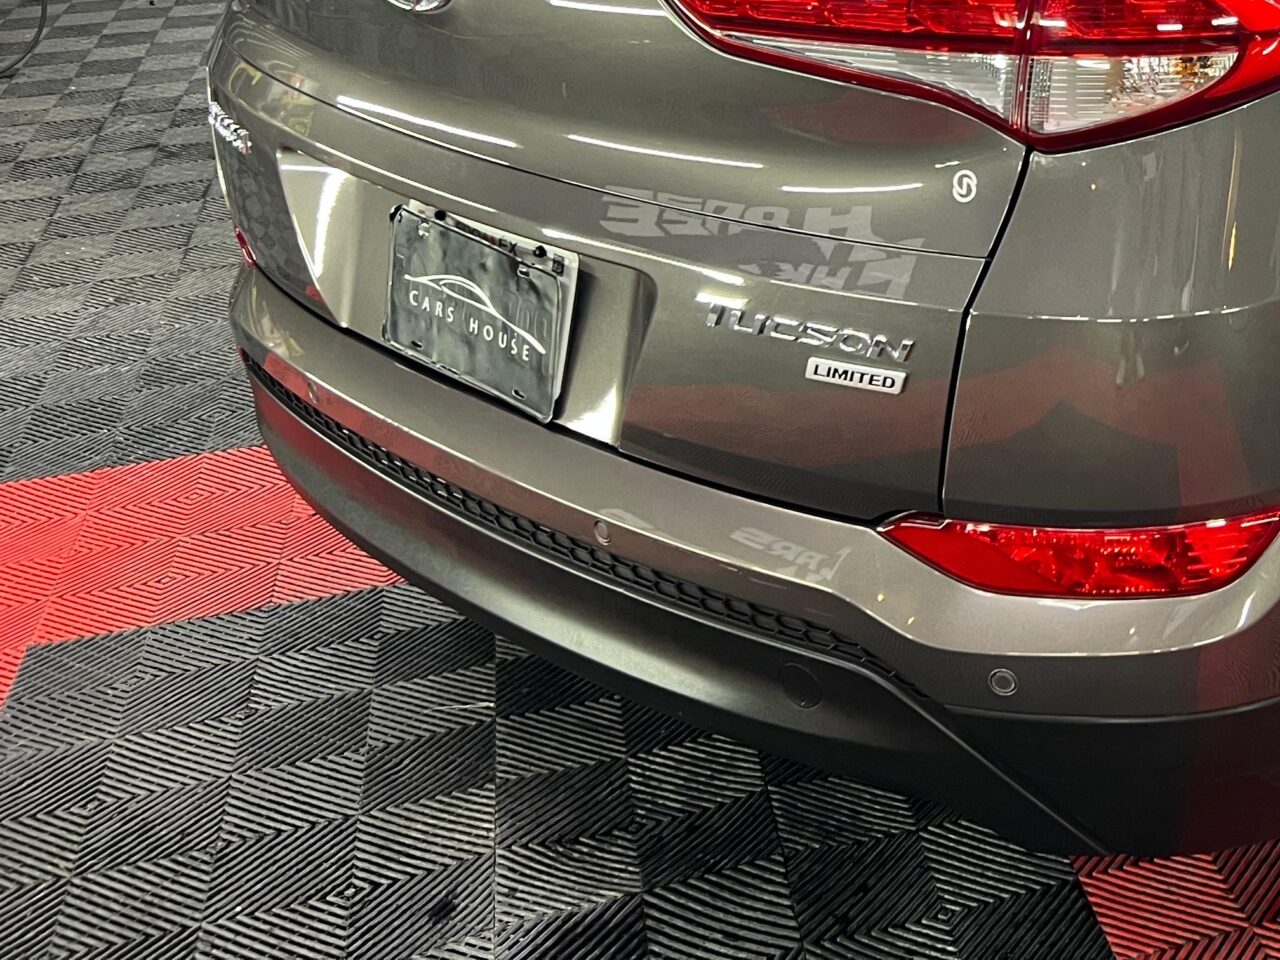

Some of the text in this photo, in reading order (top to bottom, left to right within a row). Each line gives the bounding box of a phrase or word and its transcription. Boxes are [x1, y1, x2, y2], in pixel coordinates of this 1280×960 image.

[409, 290, 530, 362] CARS HOUSE
[696, 294, 916, 362] TUCSON
[813, 364, 896, 390] LIMITED
